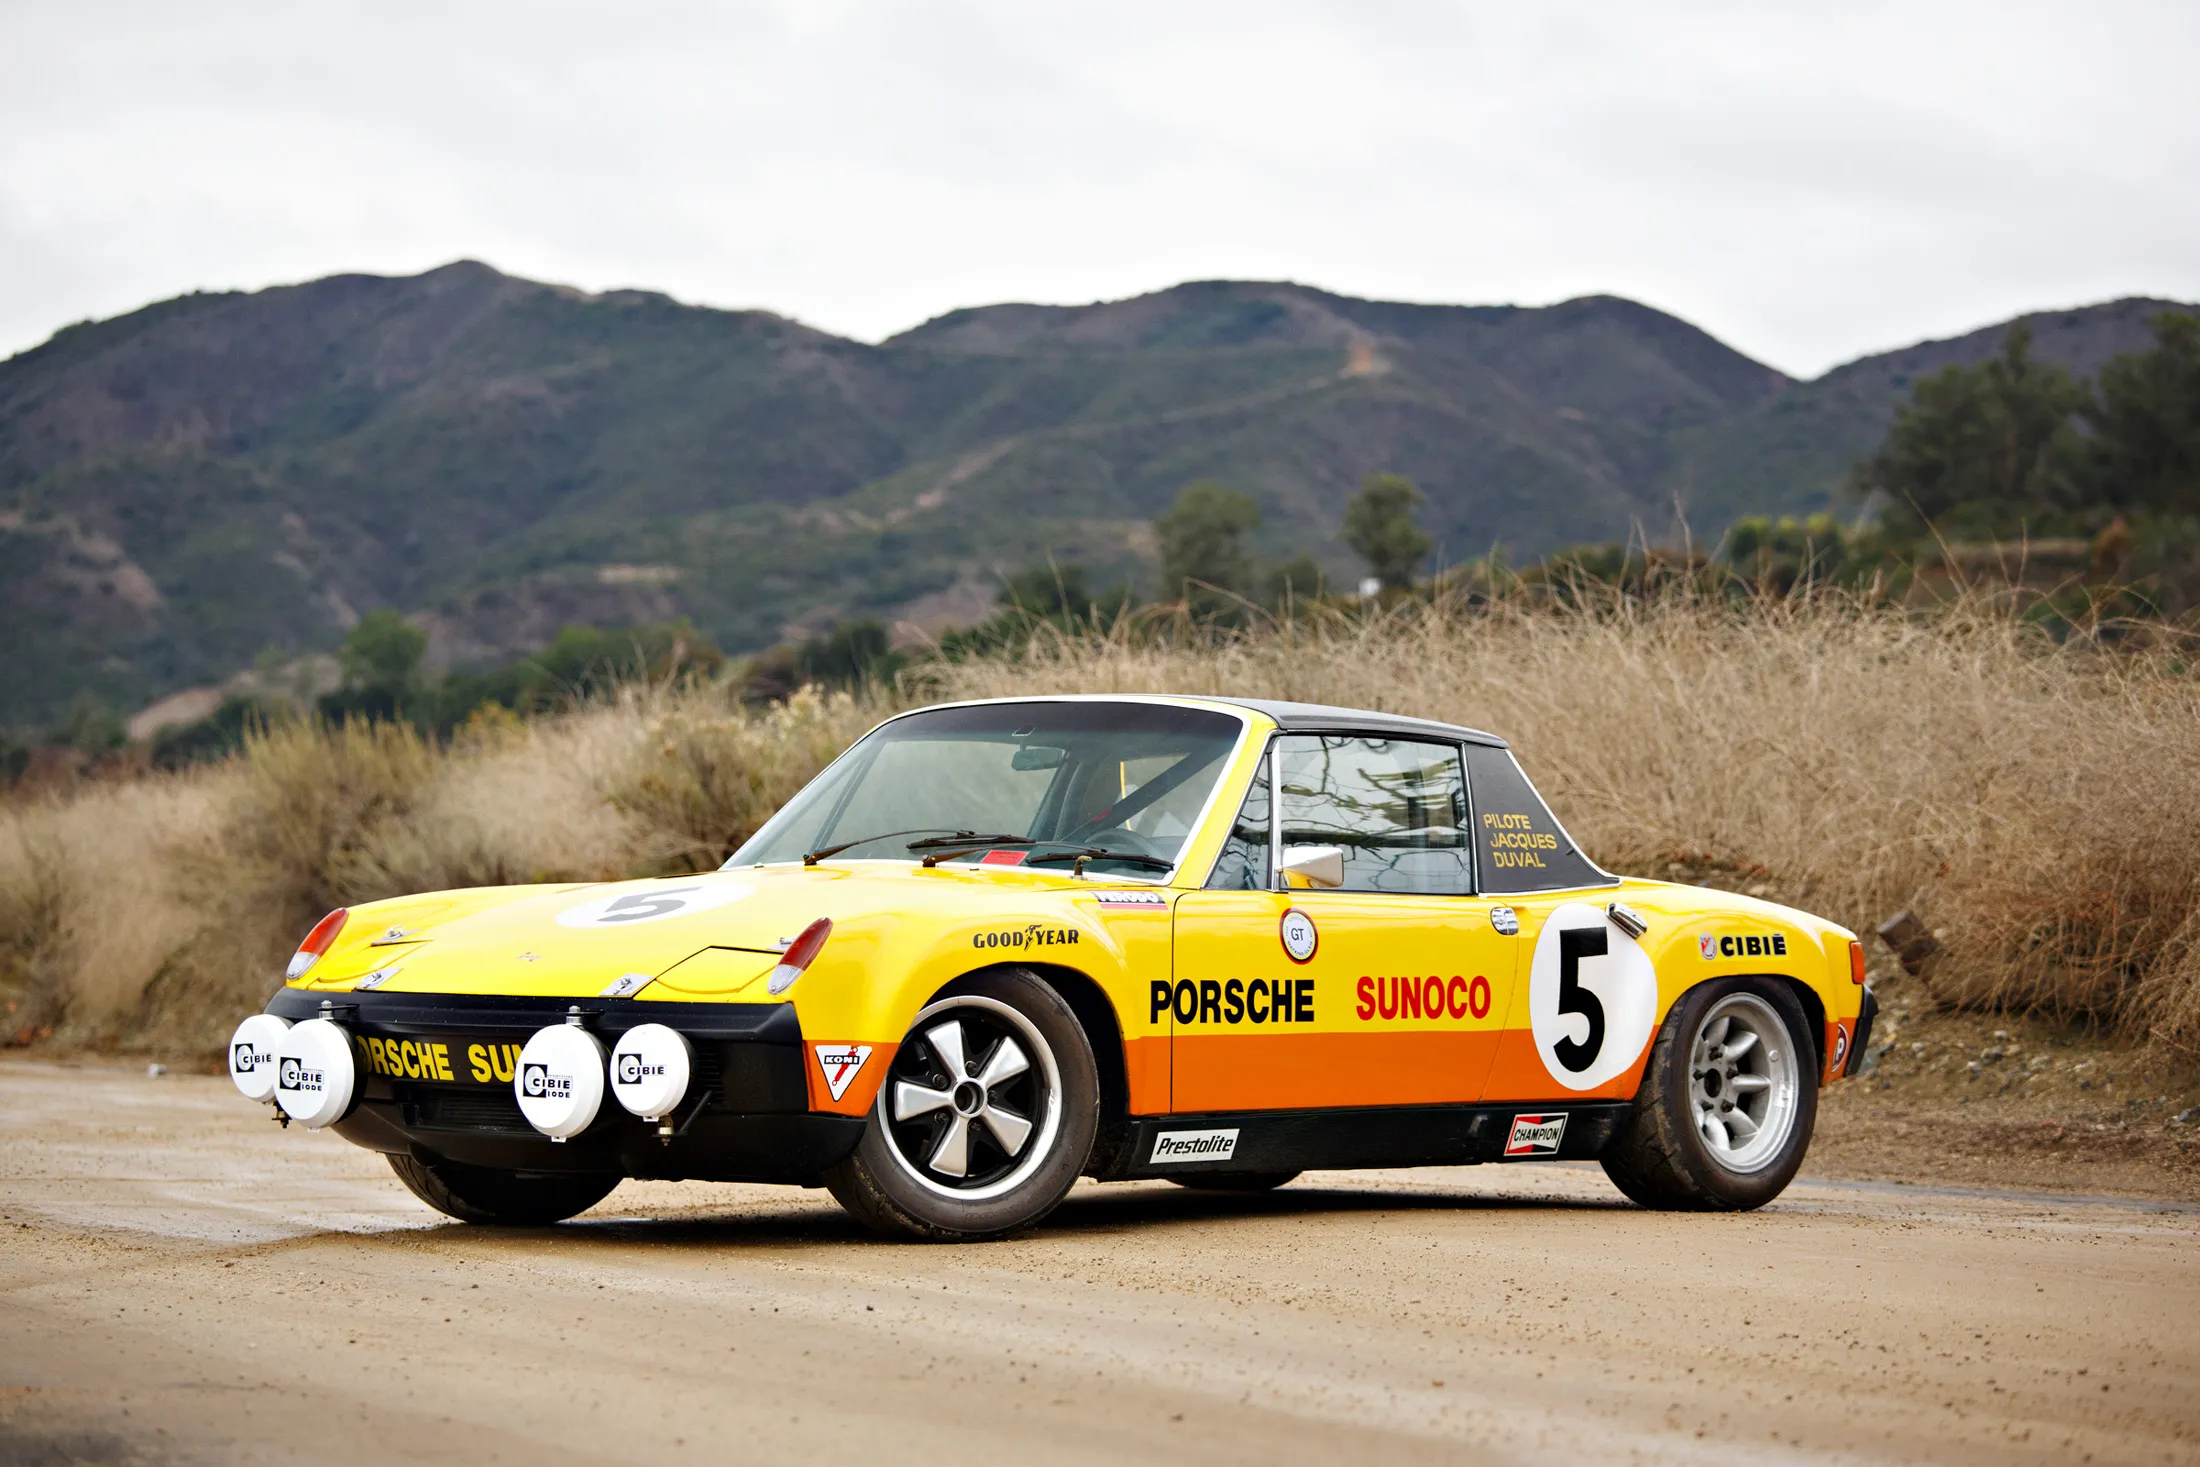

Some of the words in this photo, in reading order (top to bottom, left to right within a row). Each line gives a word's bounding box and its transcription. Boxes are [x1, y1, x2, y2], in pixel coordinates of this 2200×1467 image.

[1483, 813, 1532, 830] PILOTE
[1490, 832, 1558, 850] JACQUES
[1493, 851, 1546, 868] DUVAL
[596, 886, 703, 922] 5
[1291, 928, 1304, 940] GT
[1150, 978, 1315, 1025] PORSCHE
[1356, 975, 1491, 1021] SUNOCO
[1553, 927, 1609, 1072] 5
[355, 1035, 455, 1081] ORSCHE
[825, 1056, 859, 1064] KONI
[301, 1084, 322, 1092] IODE
[547, 1091, 571, 1099] IODE
[1514, 1128, 1559, 1141] CHAMPION
[1156, 1135, 1234, 1155] Prestolite
